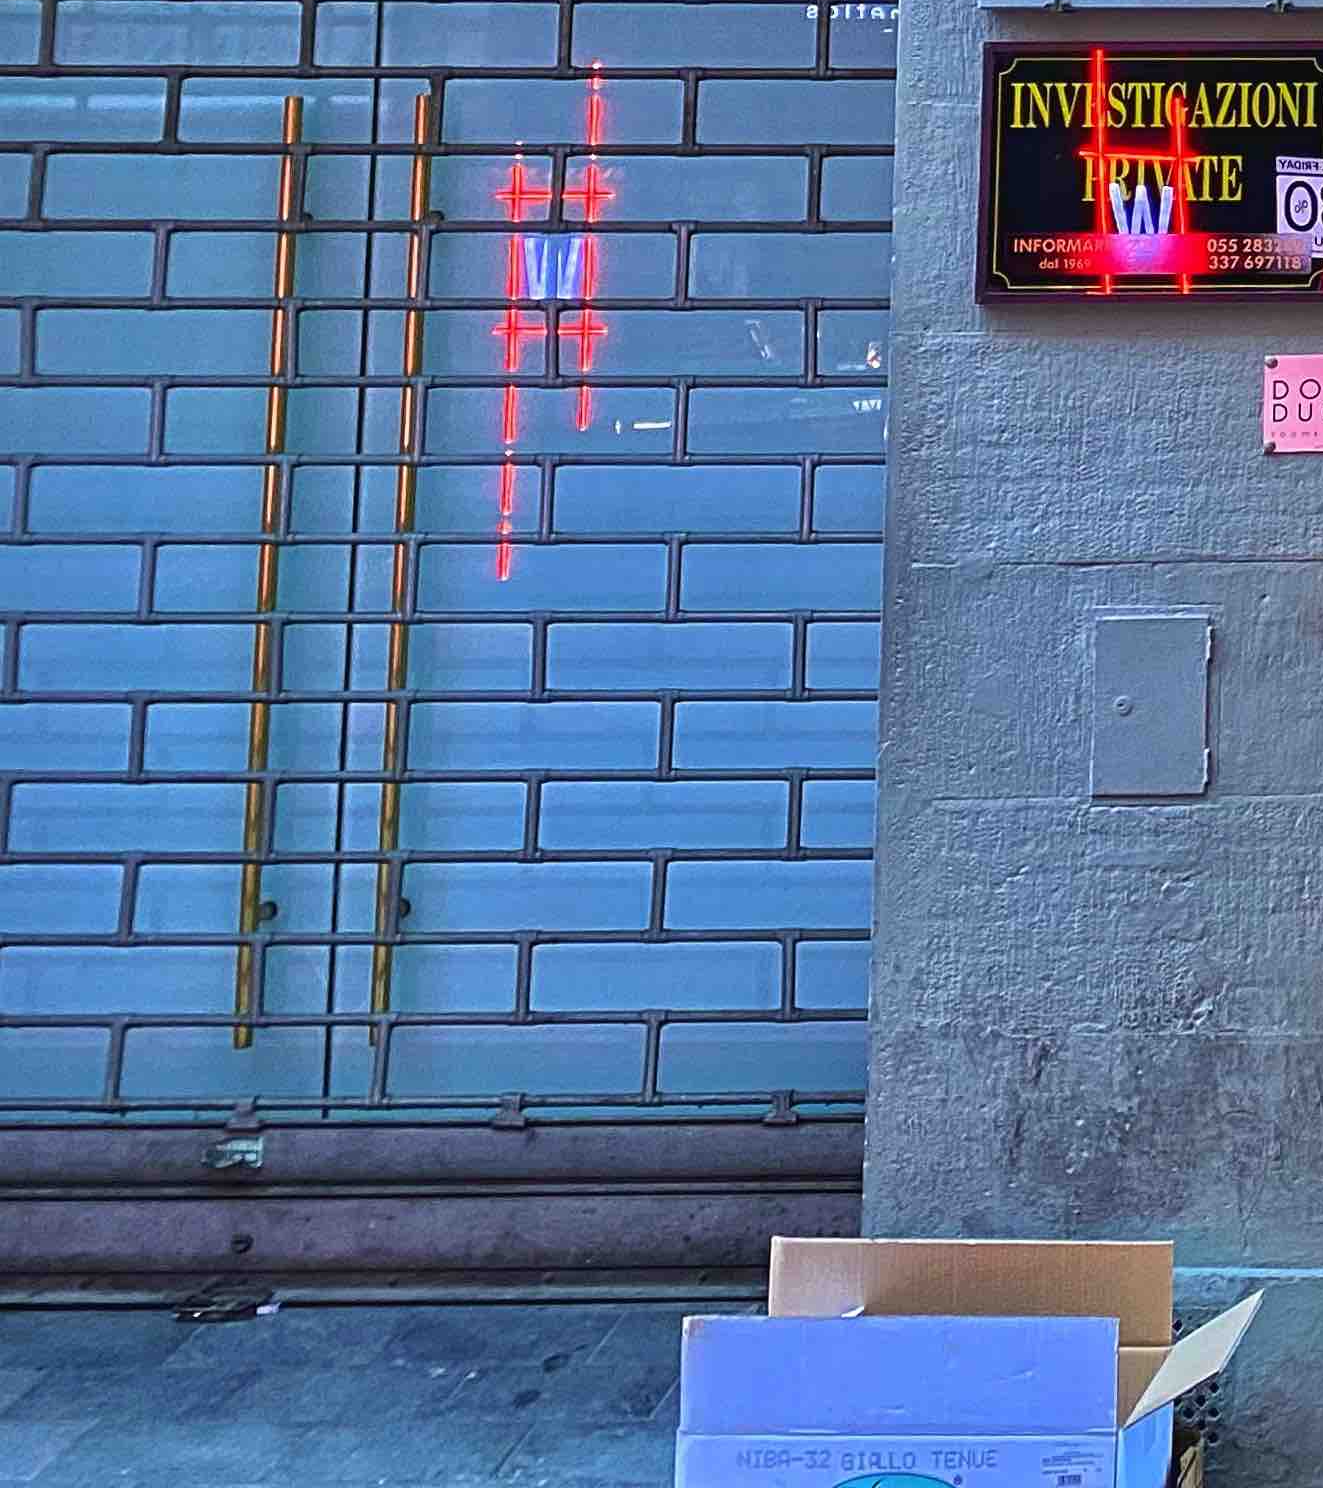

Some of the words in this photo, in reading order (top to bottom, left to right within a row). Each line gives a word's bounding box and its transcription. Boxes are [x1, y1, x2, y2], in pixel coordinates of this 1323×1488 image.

[1010, 80, 1320, 130] INVESTIGAZIONI
[1080, 155, 1243, 202] PRIVATE
[1207, 238, 1238, 253] 055
[1208, 255, 1240, 270] 337
[930, 1448, 999, 1469] TENUE
